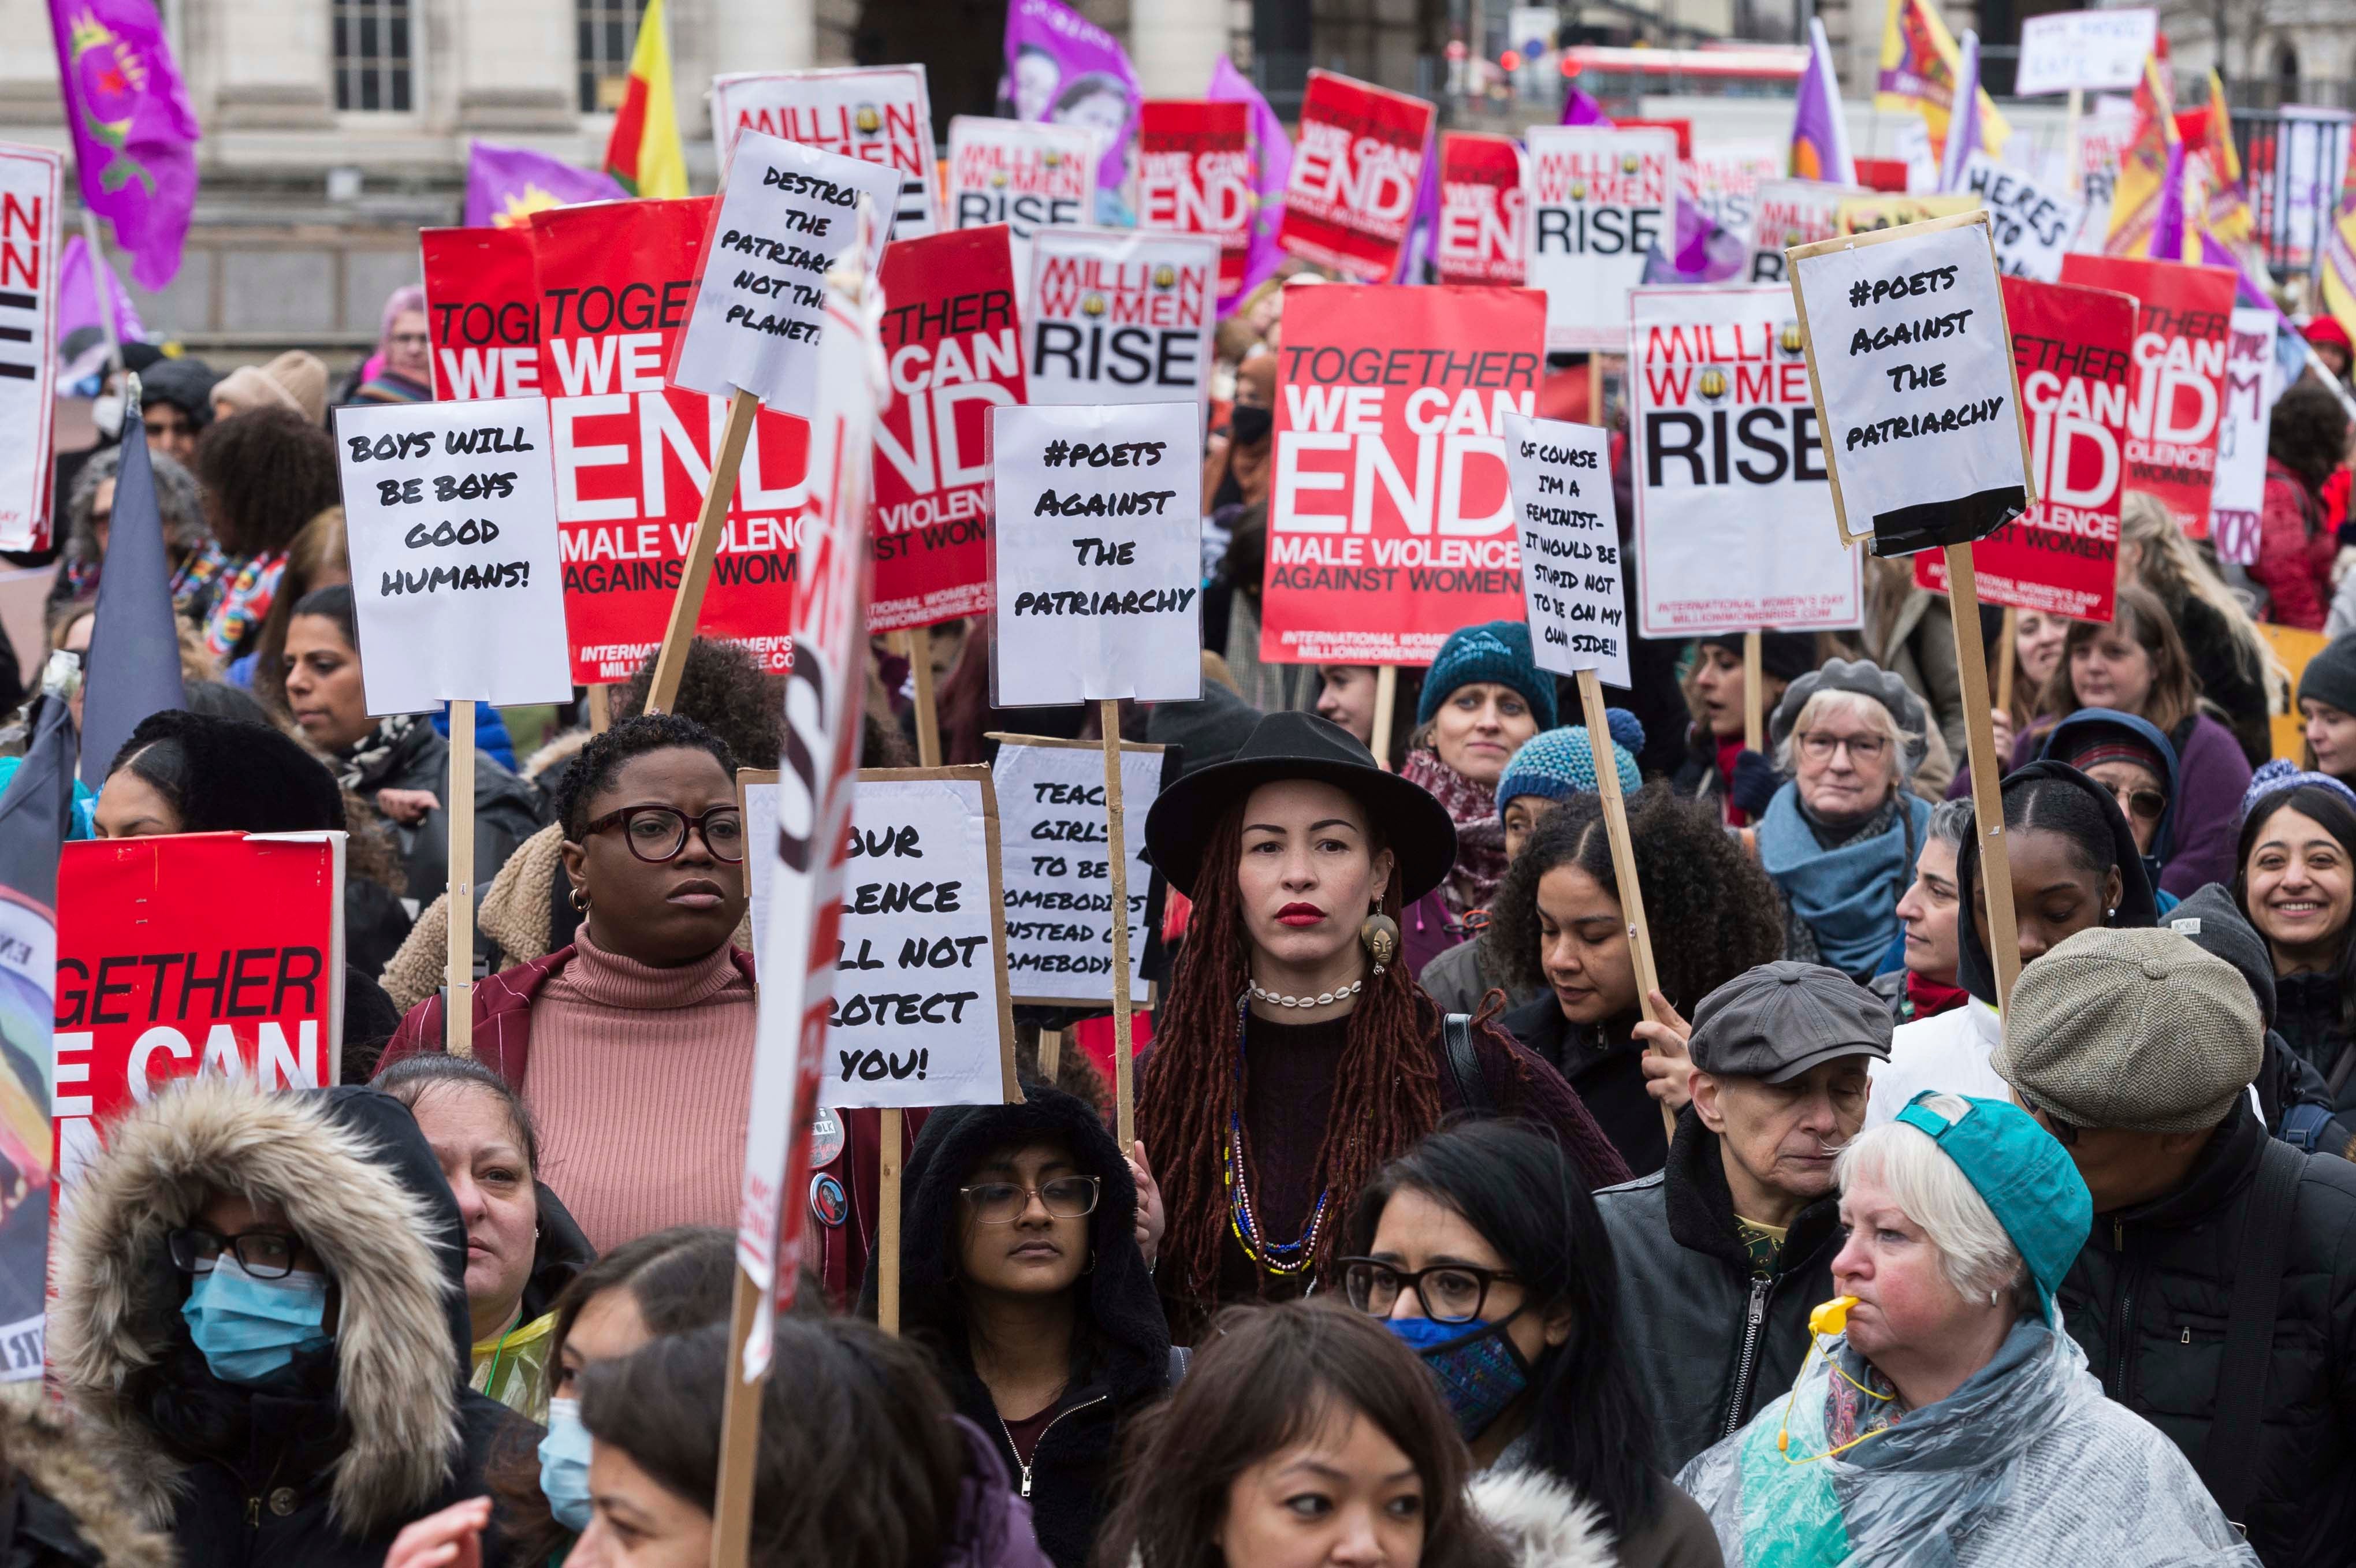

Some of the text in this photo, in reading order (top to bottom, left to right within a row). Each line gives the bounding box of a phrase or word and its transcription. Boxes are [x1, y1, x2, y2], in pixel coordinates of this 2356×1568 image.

[1289, 141, 1415, 221] END
[1539, 153, 1665, 177] MILLION
[1141, 176, 1247, 232] END
[1538, 176, 1662, 204] WOMEN
[785, 208, 832, 237] THE
[959, 192, 1080, 239] RISE
[1439, 206, 1520, 259] EN
[1536, 208, 1662, 254] RISE
[721, 230, 838, 274] PATRIARC
[734, 270, 791, 299] NOT
[1043, 256, 1207, 293] MILLION
[1848, 265, 1958, 308] #POETS
[1042, 289, 1203, 326] WOMEN
[1849, 309, 1974, 356] AGAINST
[550, 333, 665, 396] WE
[890, 328, 1019, 393] CAN
[1033, 322, 1200, 386] RISE
[1283, 347, 1538, 388] TOGETHER
[2133, 332, 2226, 378] CAN
[440, 348, 542, 400] WE
[1645, 363, 1807, 407] WOME
[1887, 362, 1947, 393] THE
[1284, 385, 1535, 437] WE CAN
[2024, 370, 2126, 429] CAN
[1846, 396, 2004, 452] PATRIARCHY
[347, 426, 534, 463] BOYS WILL
[1043, 439, 1166, 468] #POETS
[1520, 440, 1598, 469] OF COURSE
[1646, 408, 1829, 487] RISE
[377, 472, 518, 506] BE BOYS
[1273, 431, 1517, 537] END
[1538, 475, 1580, 497] I'M A
[1034, 489, 1176, 516] AGAINST
[405, 519, 500, 549] GOOD
[559, 524, 661, 563] MALE
[1073, 538, 1136, 566] THE
[1271, 537, 1363, 565] MALE
[1525, 532, 1617, 564] IT WOULD BE
[2024, 526, 2116, 561] WOMEN
[381, 561, 530, 596] HUMANS!
[564, 553, 797, 594] AGAINS WOM
[1271, 567, 1521, 594] AGAINST WOMEN
[1534, 563, 1615, 594] STUPID NOT
[1014, 587, 1196, 616] PATRIARCHY
[1534, 593, 1550, 612] TO
[1570, 602, 1596, 621] ON
[1601, 607, 1622, 627] MY
[1573, 634, 1617, 657] SIDE!!
[1033, 783, 1107, 806] TEAC
[846, 825, 923, 858] OUR
[1031, 856, 1109, 878] TO BE
[1006, 922, 1094, 944] NSTEAD
[898, 936, 988, 969] NOT
[55, 946, 322, 1028] GETHER
[127, 1020, 318, 1106] CAN
[839, 1048, 928, 1082] YOU!
